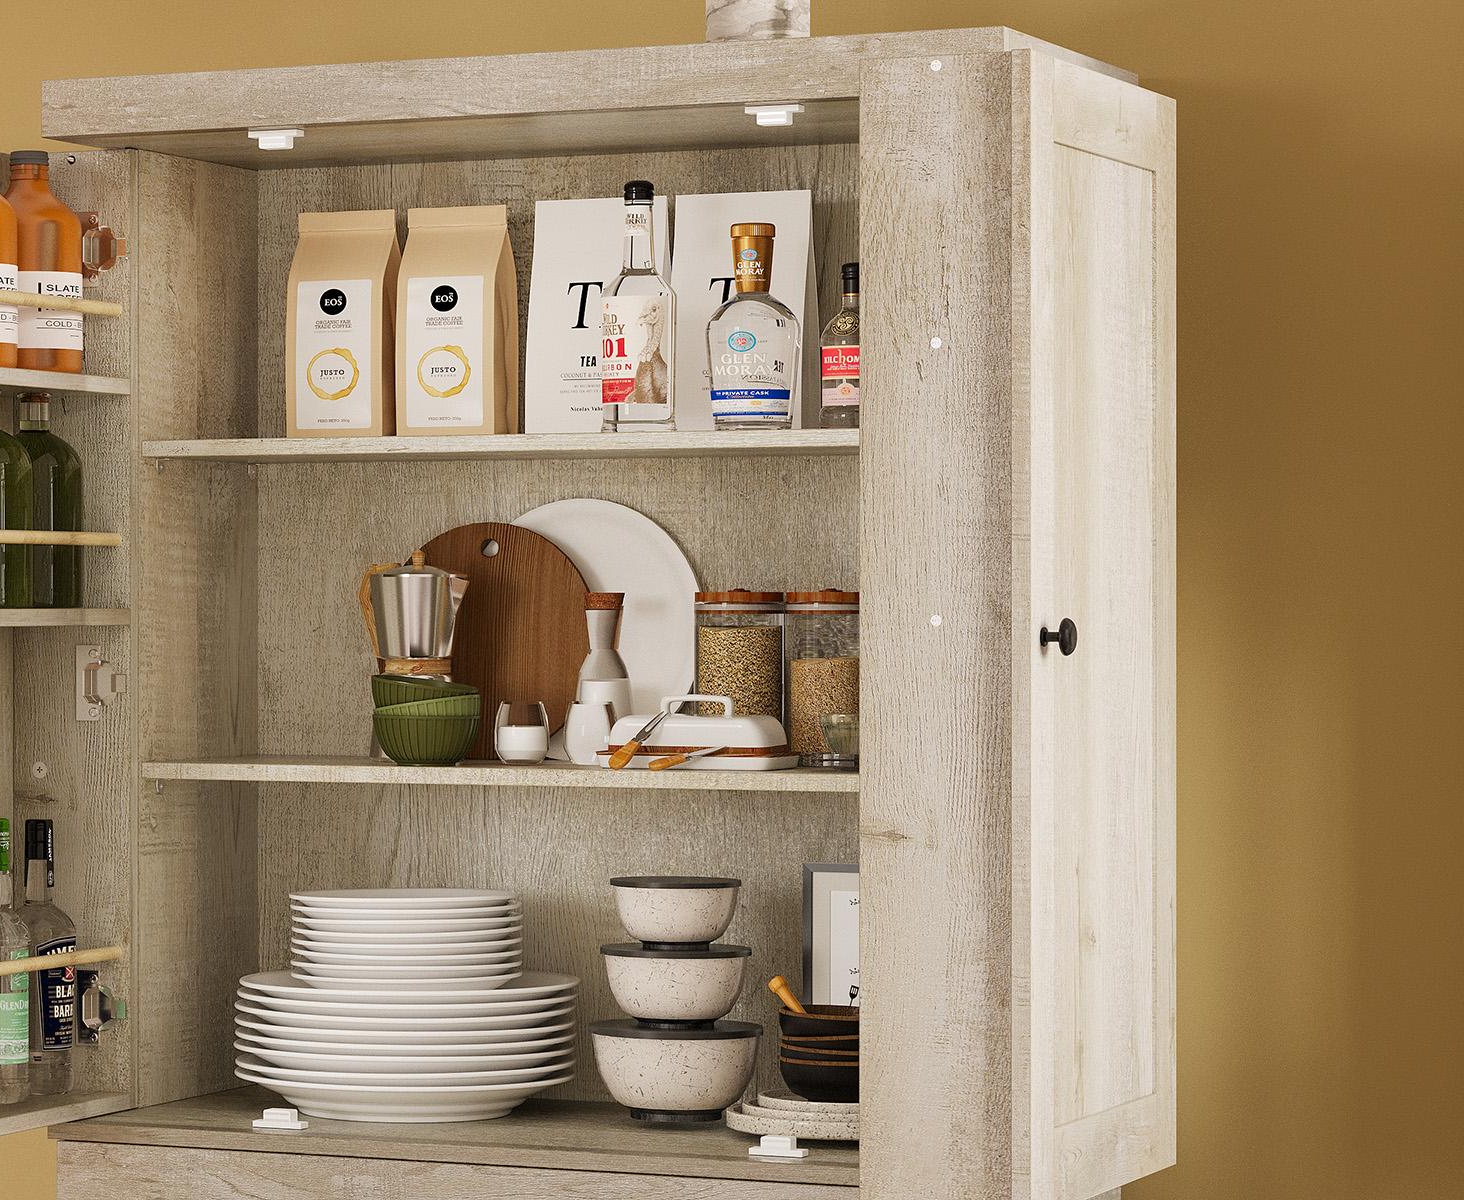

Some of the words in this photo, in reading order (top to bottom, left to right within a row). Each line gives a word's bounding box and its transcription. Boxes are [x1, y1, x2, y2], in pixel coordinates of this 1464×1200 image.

[737, 261, 762, 269] GLEN
[45, 283, 80, 294] SLATE
[580, 355, 598, 368] TEA
[720, 353, 766, 364] GLEN
[320, 368, 345, 378] JUSTO
[431, 366, 456, 375] JUSTO
[714, 364, 778, 377] MORAY
